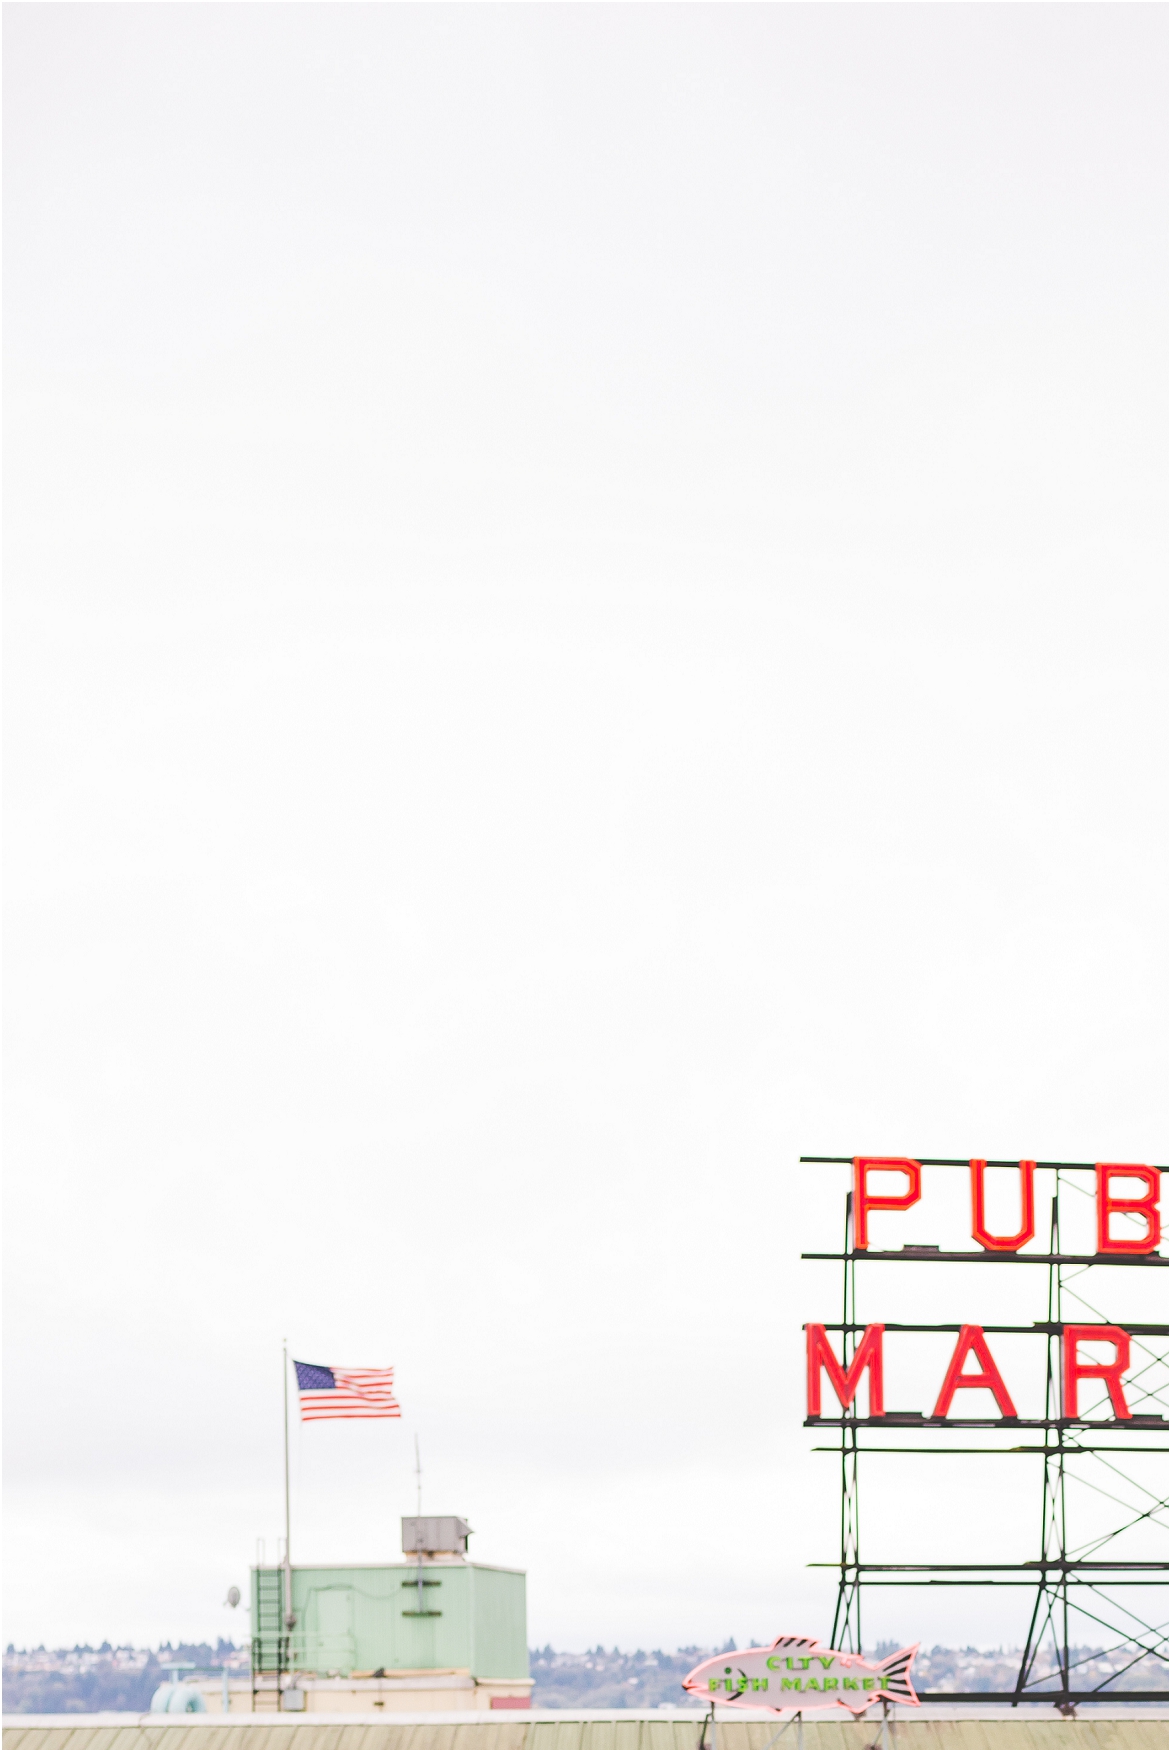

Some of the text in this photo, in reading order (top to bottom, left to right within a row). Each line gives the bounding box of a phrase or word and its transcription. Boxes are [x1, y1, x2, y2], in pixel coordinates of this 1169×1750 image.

[766, 1656, 835, 1672] CITY
[708, 1676, 890, 1692] FISH MARKET
